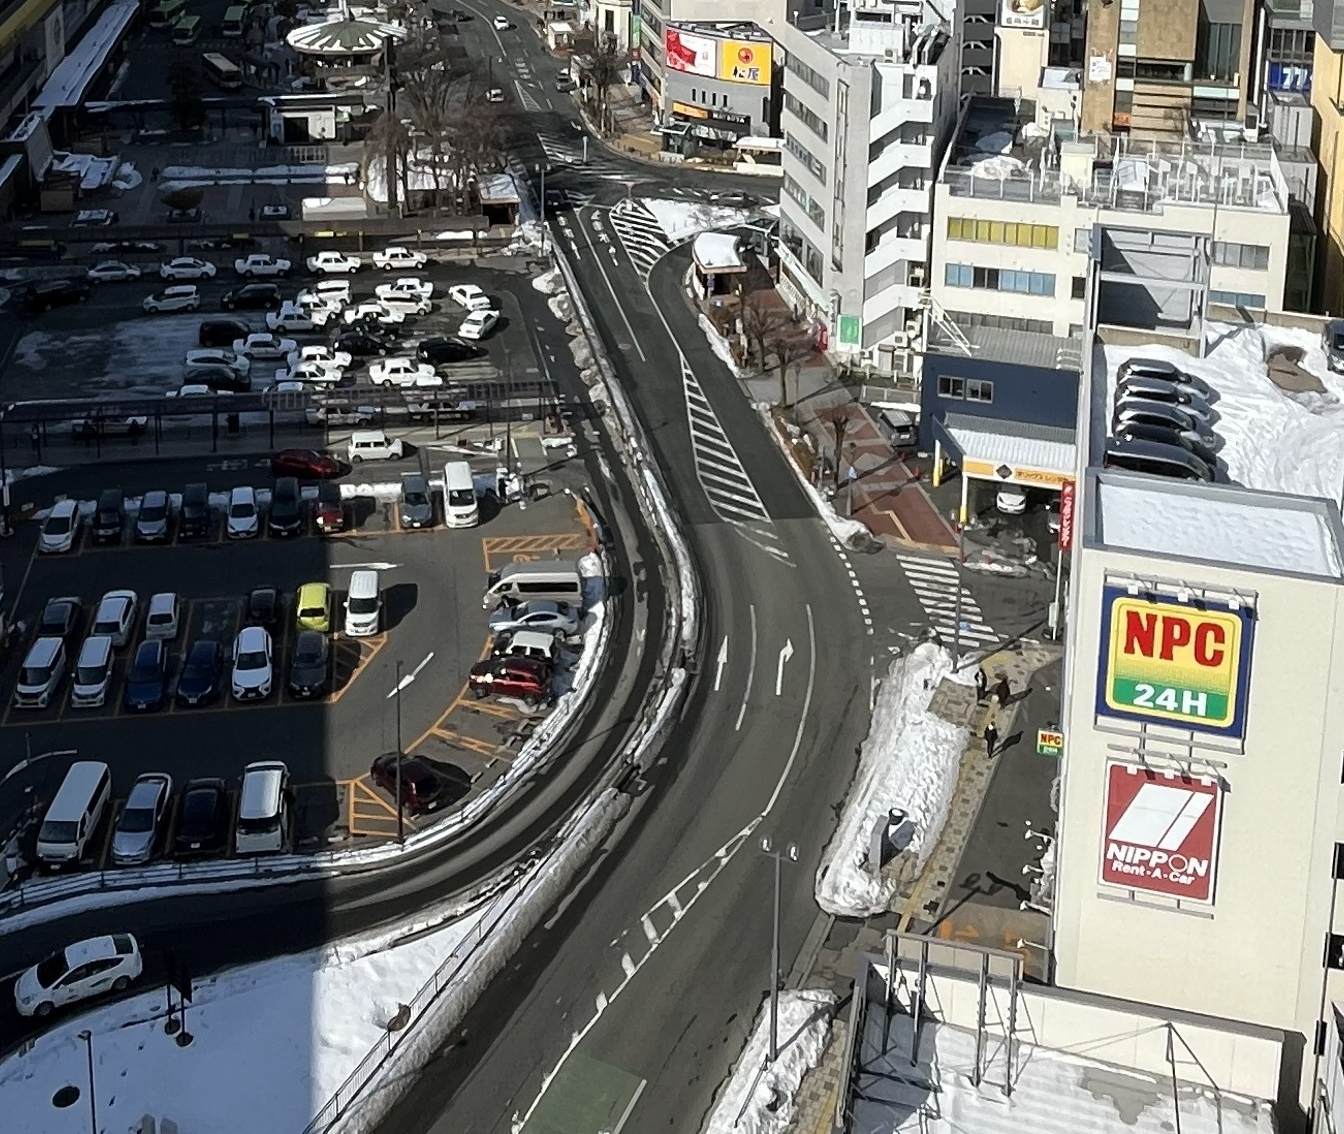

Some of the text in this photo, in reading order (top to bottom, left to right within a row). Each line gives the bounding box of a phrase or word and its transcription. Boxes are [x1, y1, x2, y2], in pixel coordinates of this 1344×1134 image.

[733, 66, 759, 81] 松屋
[1123, 609, 1226, 668] NPC
[1132, 683, 1208, 717] 24H
[1040, 733, 1062, 746] NPC
[1105, 842, 1210, 877] NIPPON
